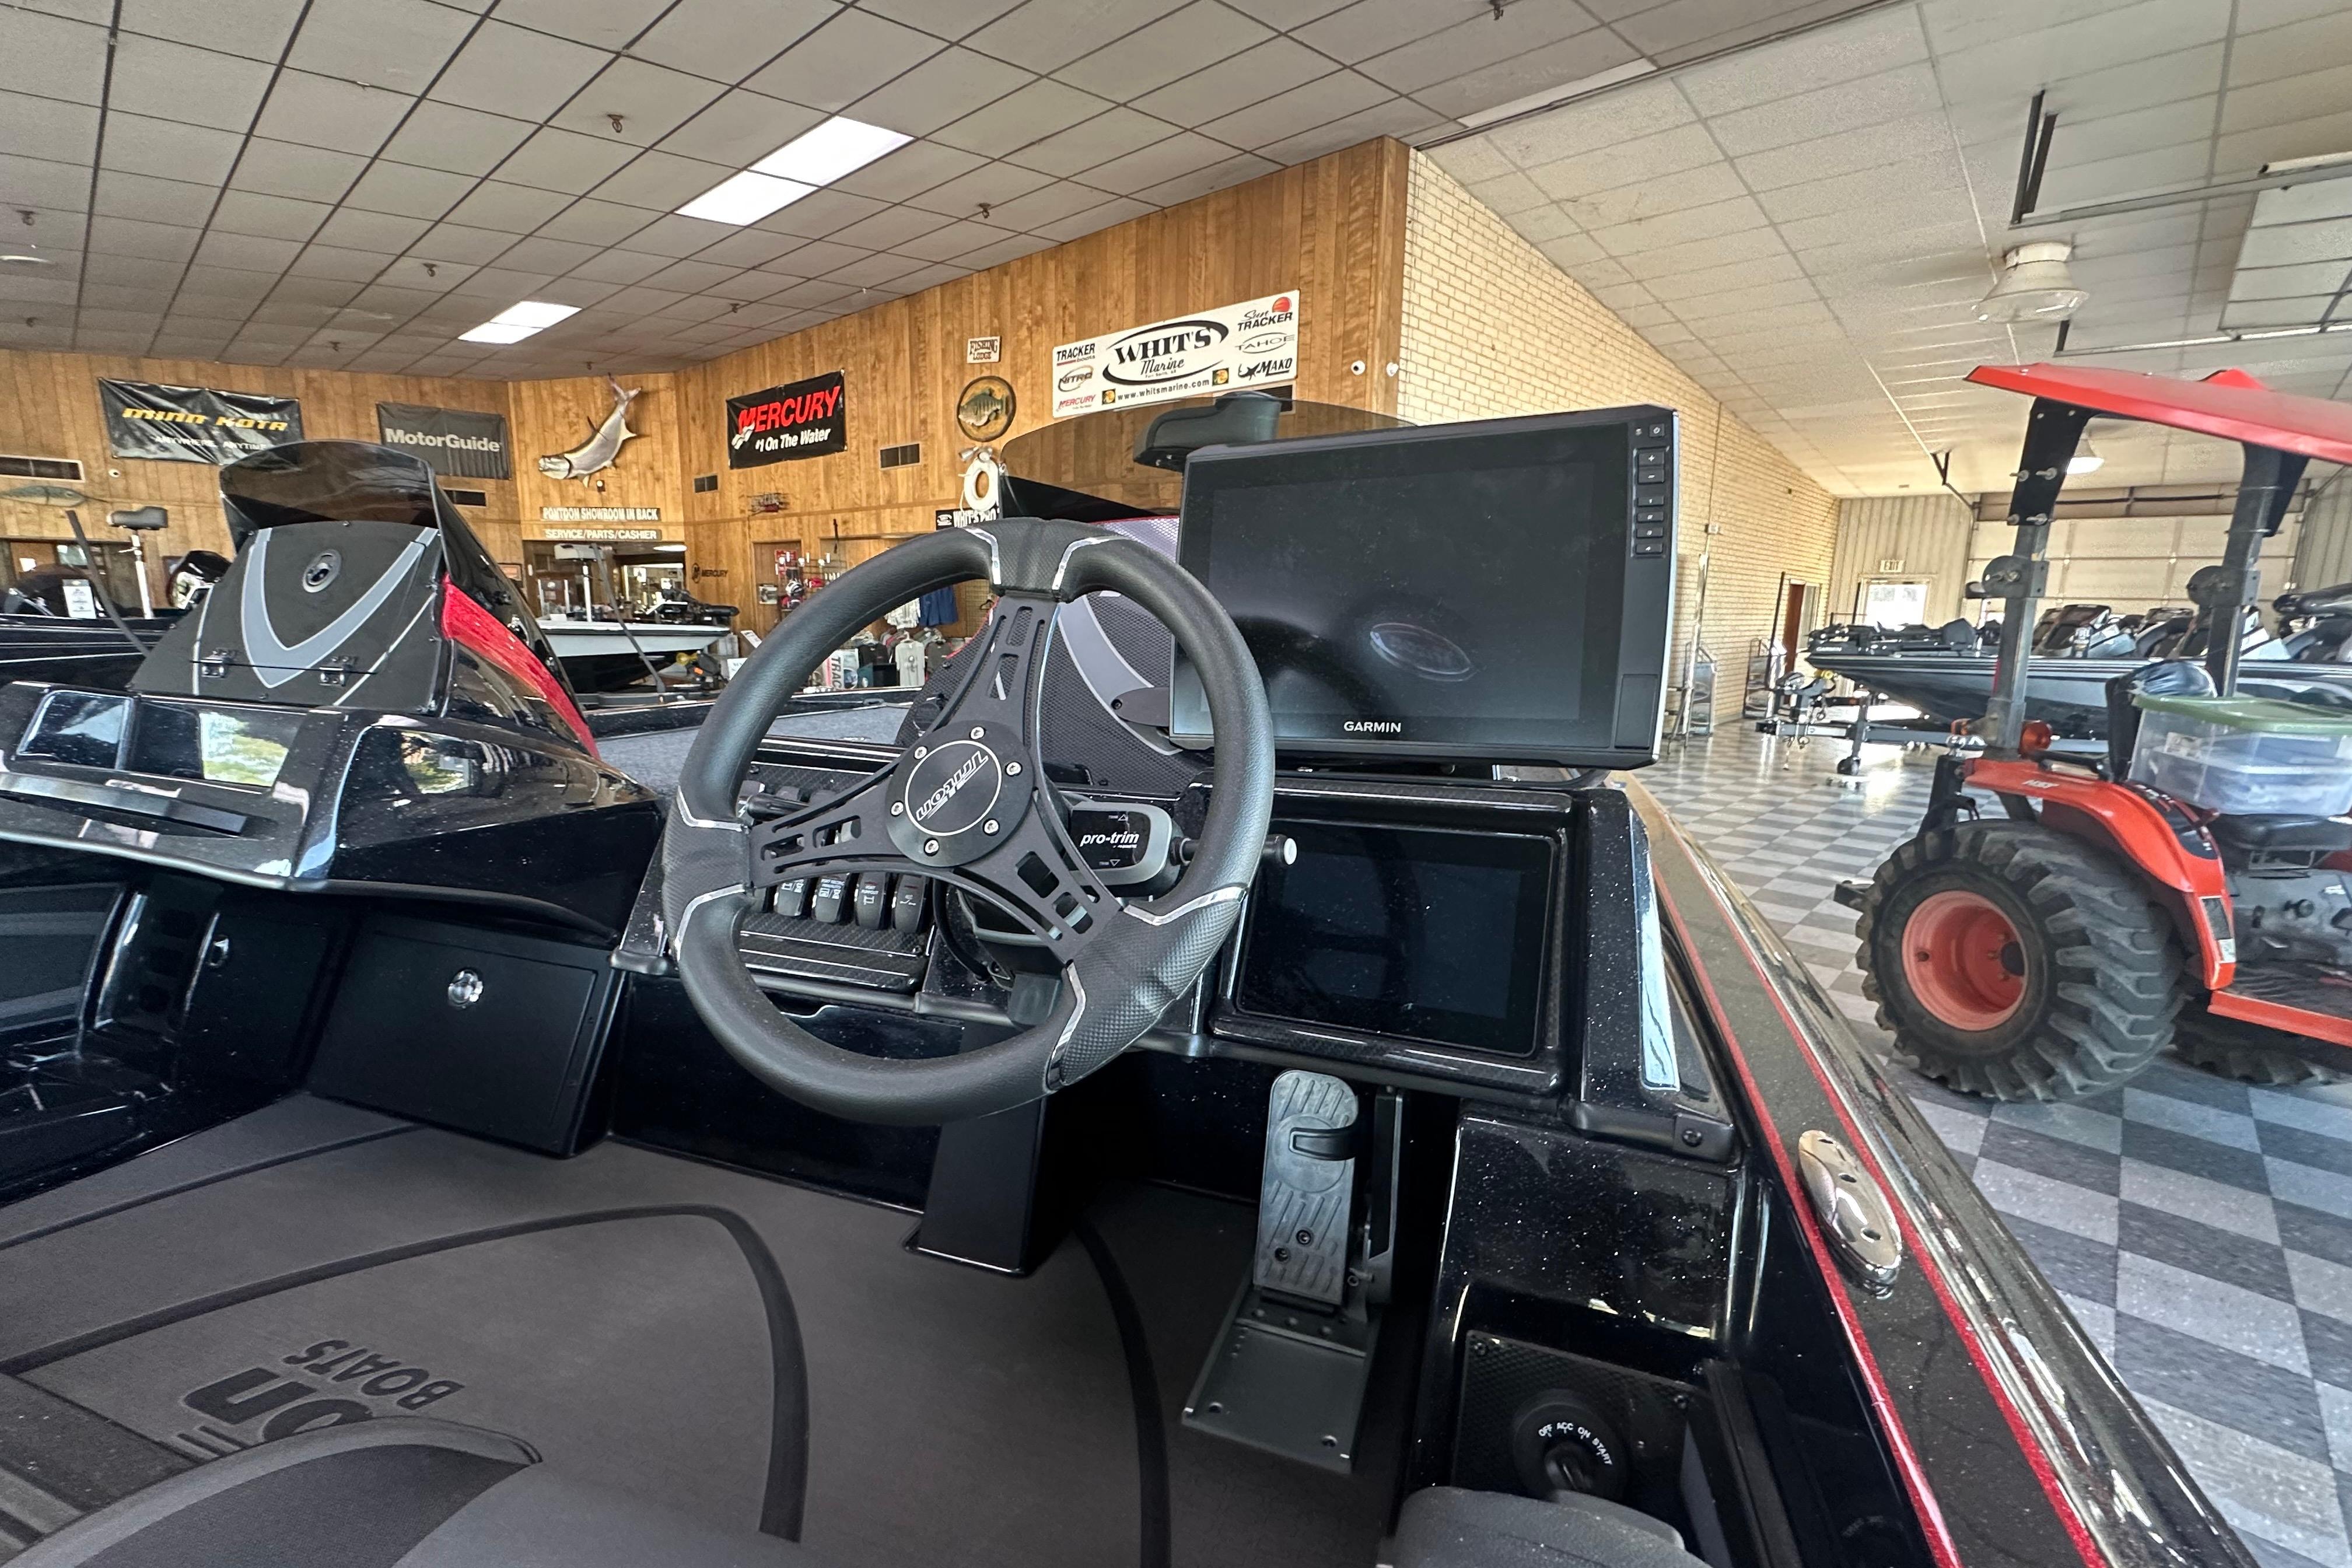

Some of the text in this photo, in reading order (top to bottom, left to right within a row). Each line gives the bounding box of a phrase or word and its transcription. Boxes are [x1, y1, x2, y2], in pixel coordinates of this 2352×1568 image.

[1237, 312, 1293, 331] TRACKER
[970, 339, 998, 355] FISHING
[1114, 327, 1212, 365] WHIT'S
[1234, 334, 1295, 351] TAHOE
[1056, 343, 1096, 362] TRACKER
[1140, 357, 1185, 376] Marine
[1255, 357, 1293, 377] MAKO
[1117, 379, 1210, 401] www.whitsmarine.com
[738, 385, 841, 435] MERCURY
[1058, 394, 1096, 410] MERCURY
[215, 416, 288, 431] KOTA
[385, 428, 501, 452] MotorGuide
[765, 436, 778, 452] On
[780, 433, 798, 449] The
[800, 428, 831, 445] Water
[543, 507, 658, 520] PONTOON SHOWROOM IN BACK
[545, 528, 657, 540] SERVICE/PARTS/CASHIER
[1343, 721, 1401, 733] GARMIN
[1080, 831, 1140, 847] pro-trim
[282, 1339, 466, 1410] BOATS
[1557, 1422, 1574, 1430] ACC
[1577, 1426, 1591, 1438] ON
[1592, 1437, 1613, 1465] START
